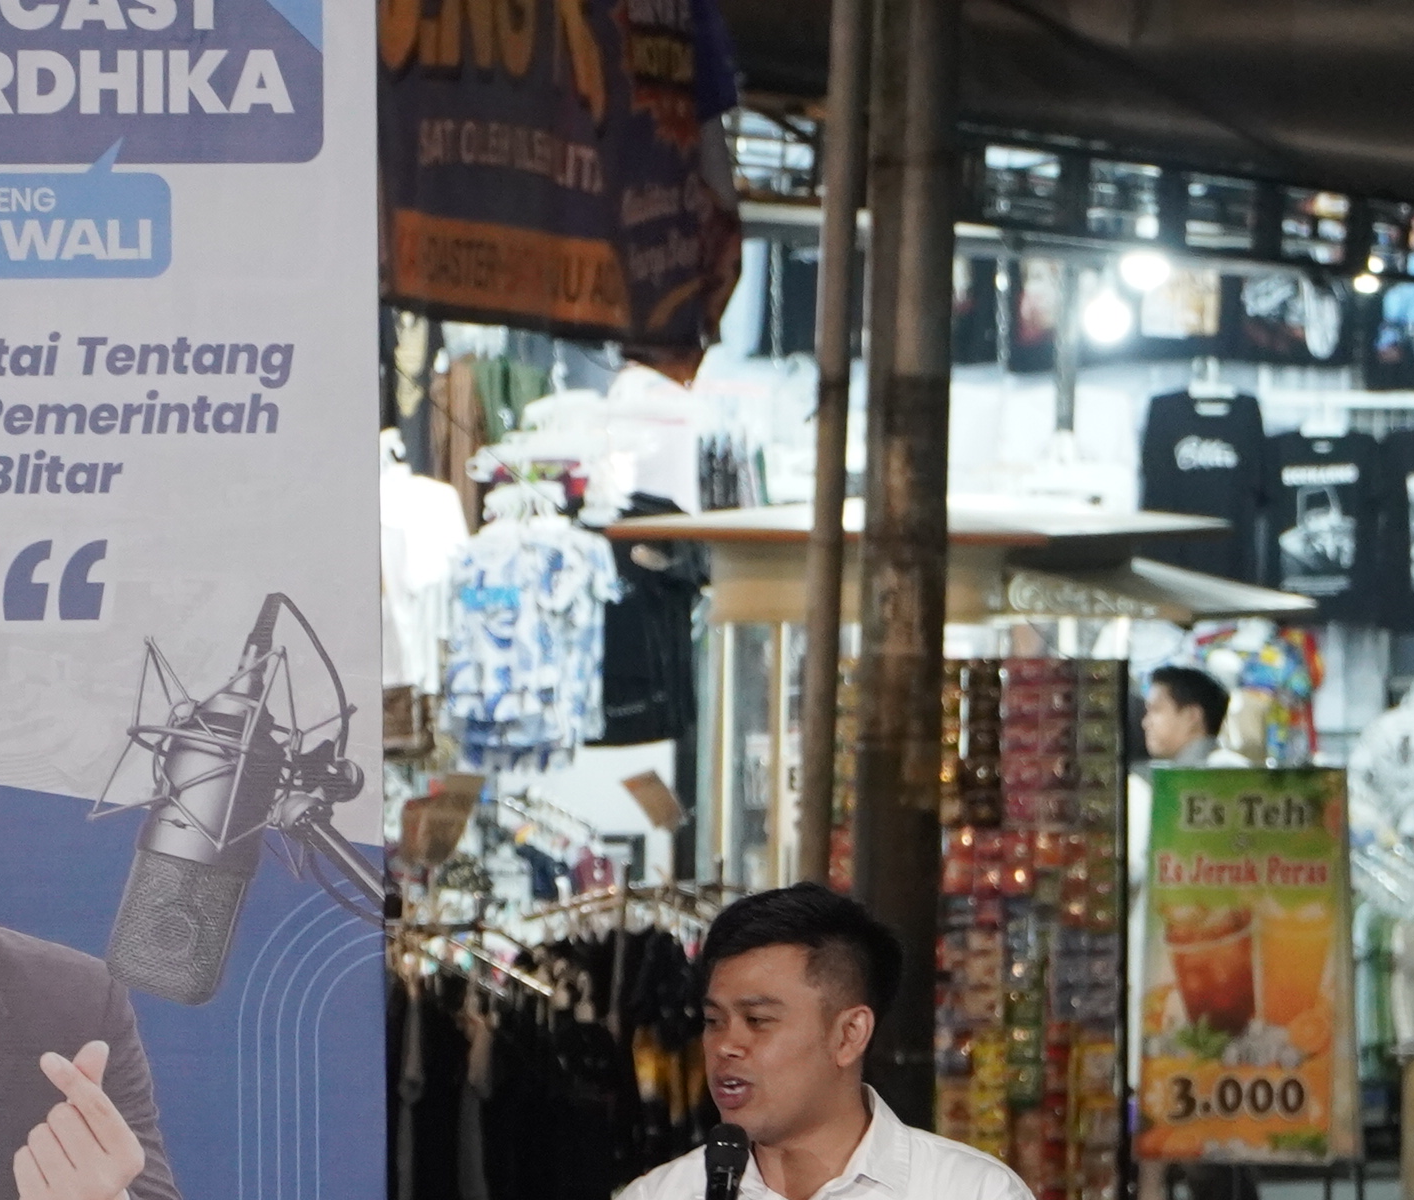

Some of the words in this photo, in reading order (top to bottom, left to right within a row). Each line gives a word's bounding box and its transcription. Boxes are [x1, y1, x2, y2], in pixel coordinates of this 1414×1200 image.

[5, 219, 152, 260] WALI
[78, 337, 294, 389] Tentang
[1187, 795, 1226, 827] Es
[1240, 795, 1306, 827] Teh
[1168, 1077, 1305, 1120] 3.000
